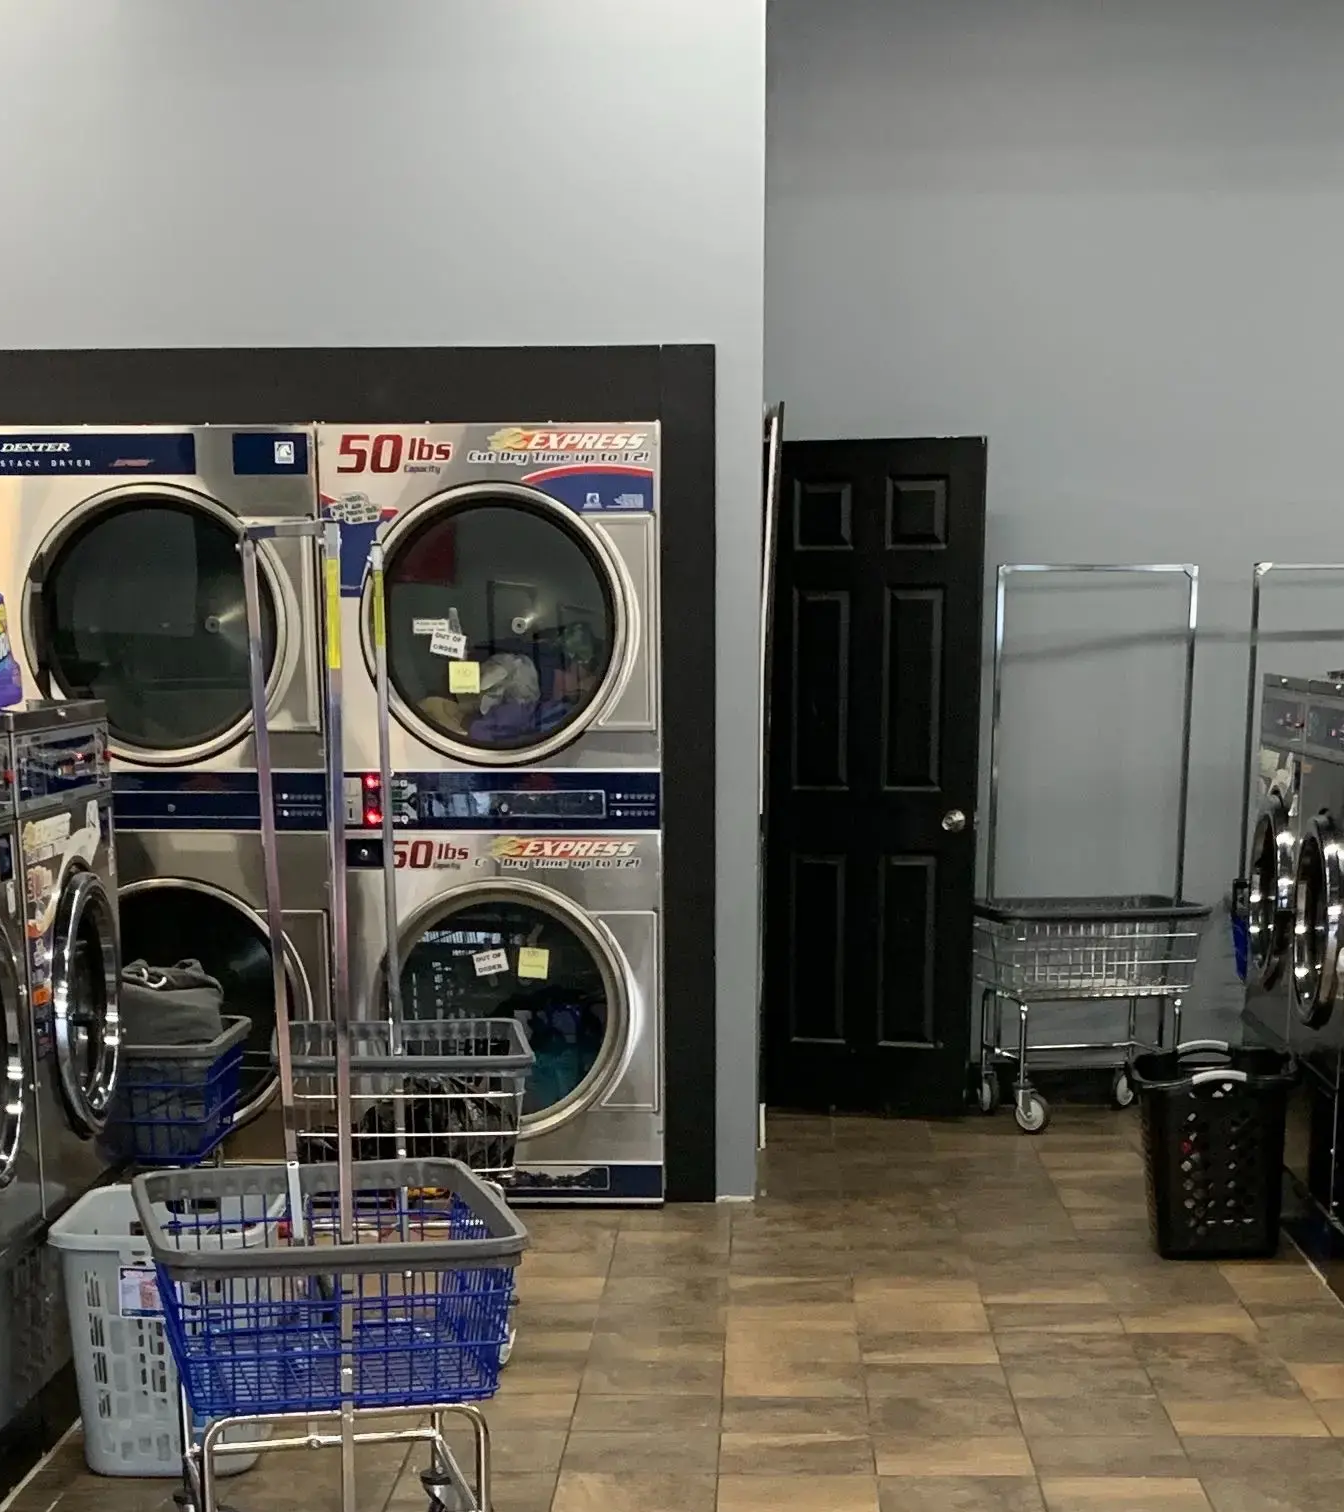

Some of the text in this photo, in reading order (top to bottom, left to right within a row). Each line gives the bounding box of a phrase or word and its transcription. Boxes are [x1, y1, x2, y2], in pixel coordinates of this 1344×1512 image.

[0, 442, 71, 453] DEXTER
[529, 433, 648, 451] EXPRESS
[0, 459, 91, 468] STACK DRYER
[468, 451, 494, 462] Cut
[499, 452, 528, 464] Dry
[575, 453, 596, 464] up
[601, 452, 618, 461] to
[523, 841, 637, 857] EXPRESS
[503, 859, 529, 869] Dry
[572, 860, 591, 870] up
